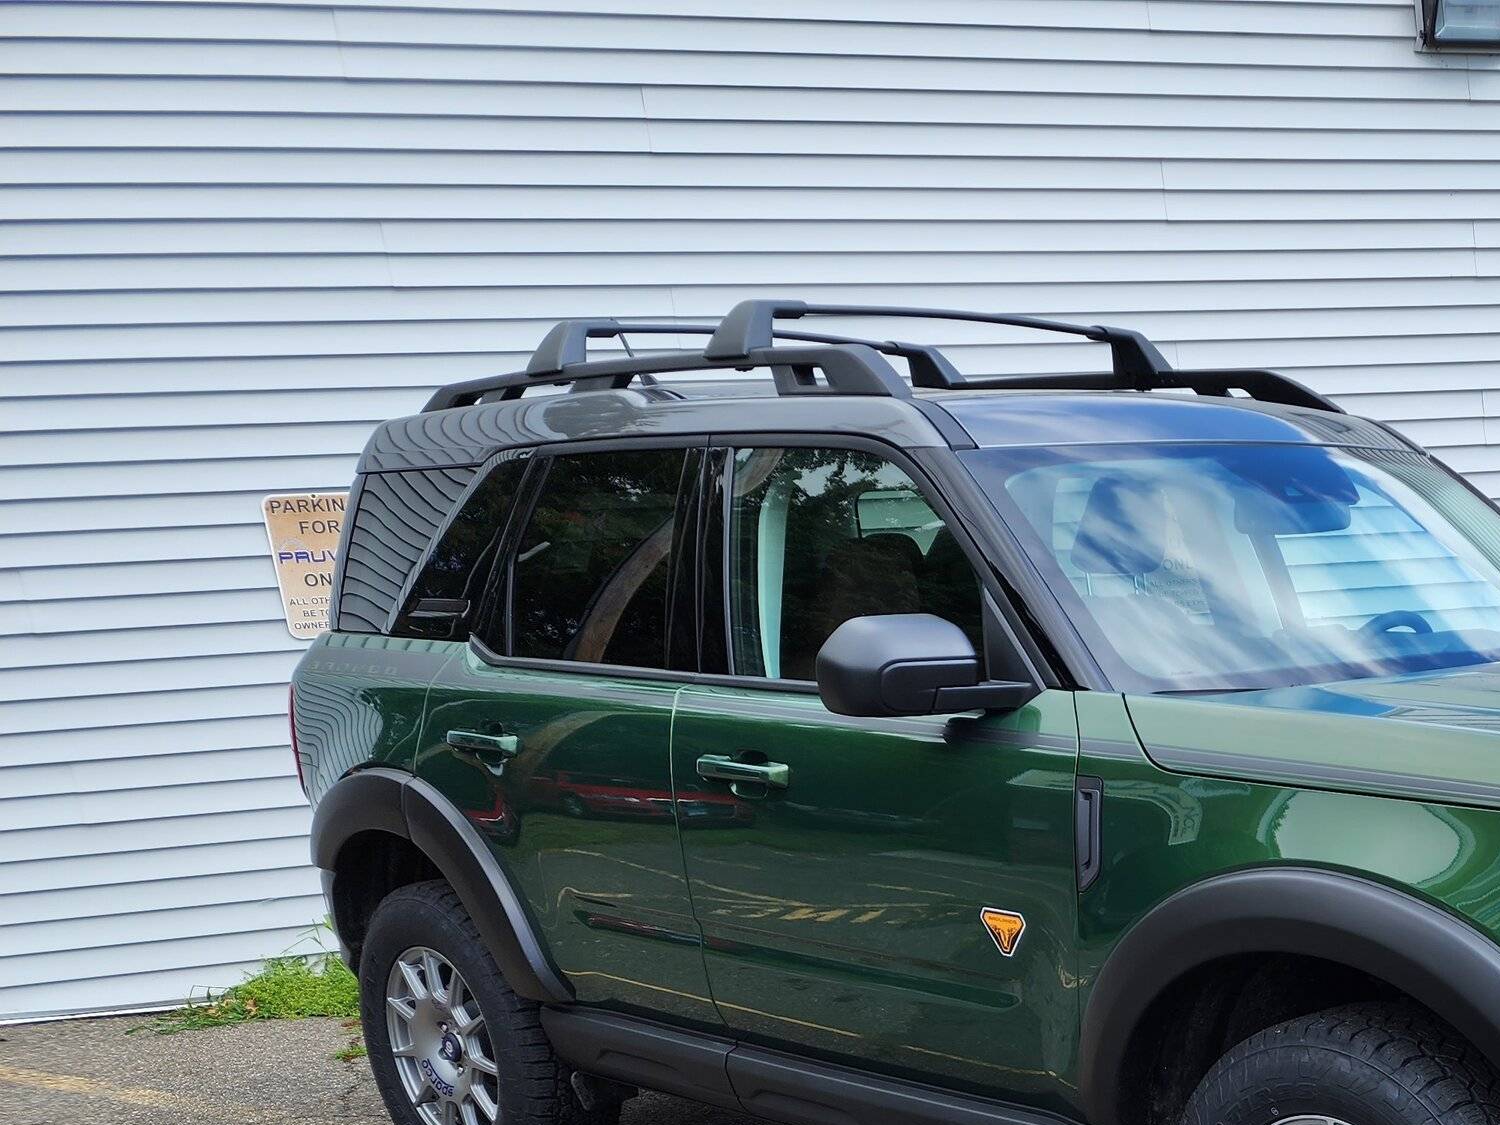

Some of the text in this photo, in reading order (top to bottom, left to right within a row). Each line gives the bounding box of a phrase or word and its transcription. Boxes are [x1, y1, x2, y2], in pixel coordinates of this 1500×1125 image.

[269, 498, 345, 514] PARKIN
[299, 520, 340, 534] FOR
[304, 572, 332, 587] ON
[290, 598, 308, 606] ALL
[302, 609, 317, 617] BE
